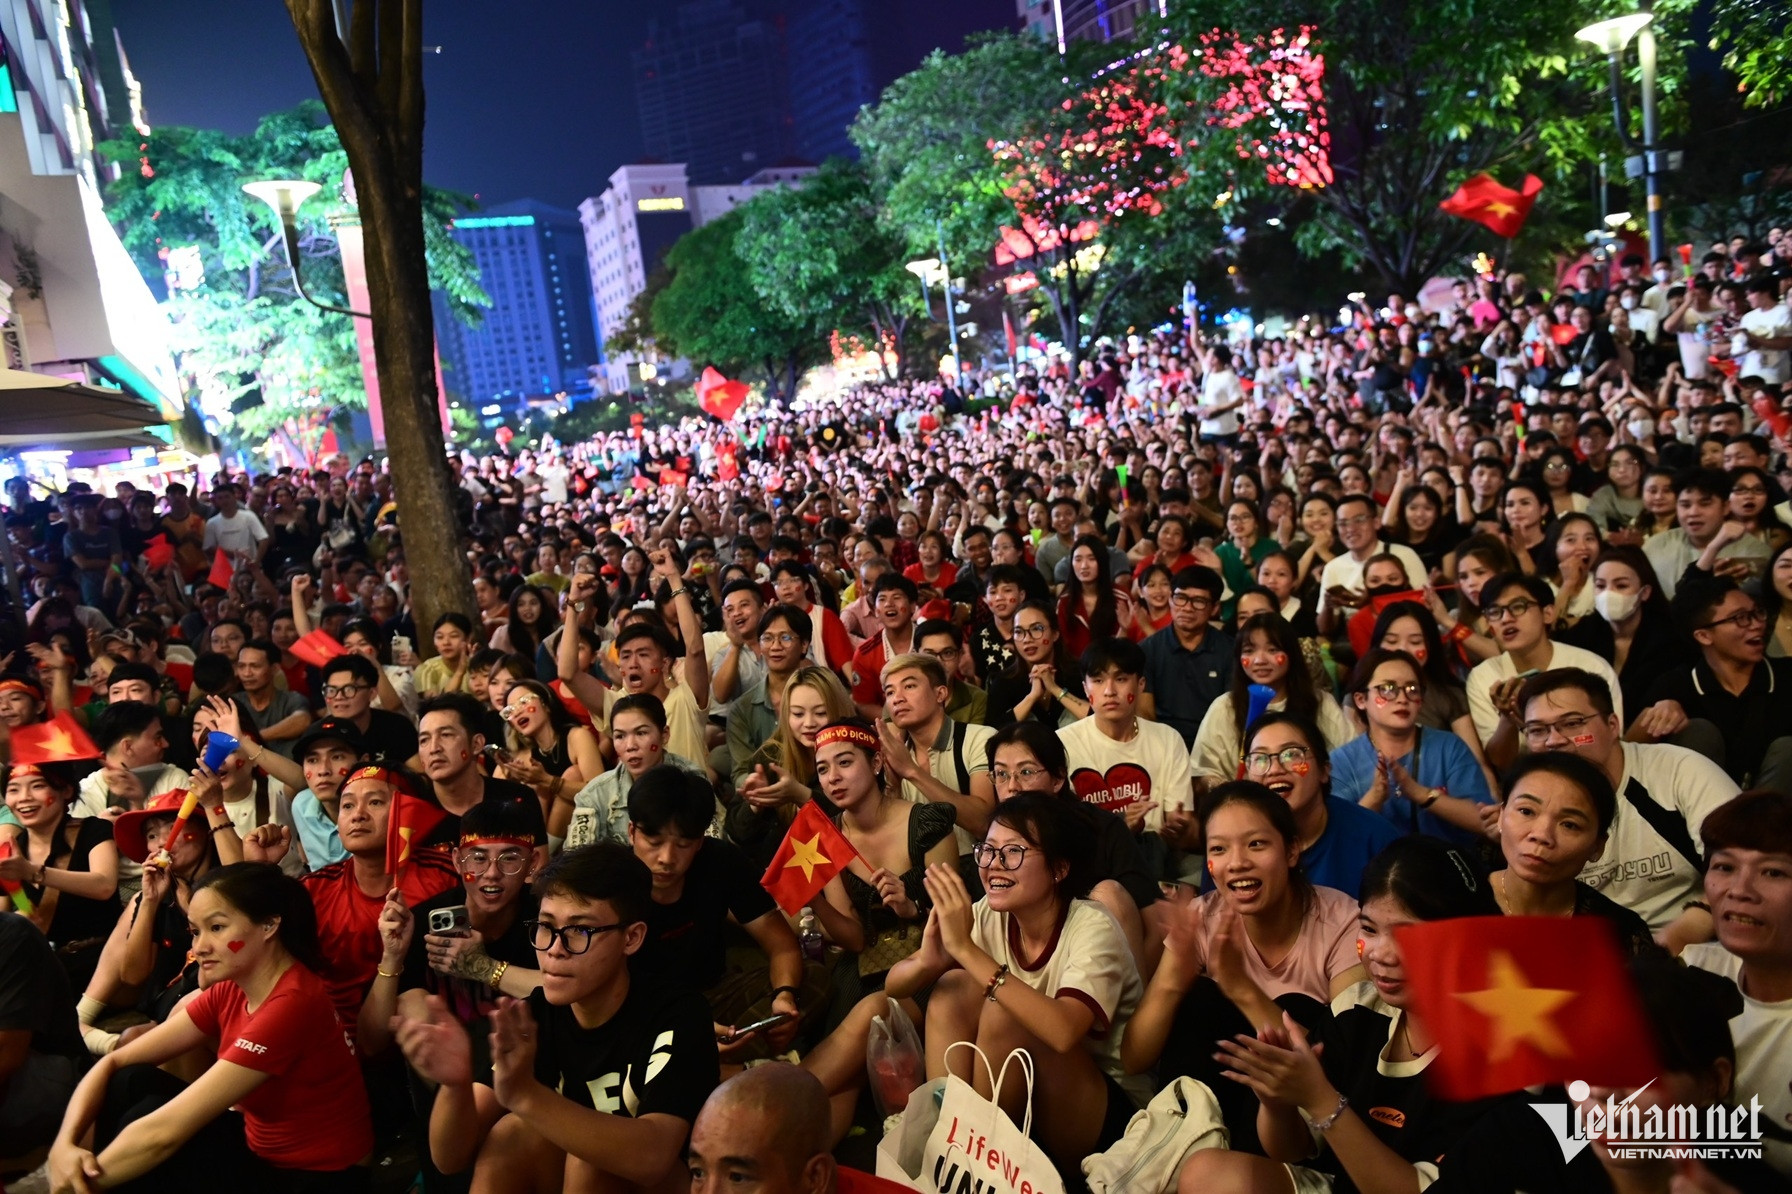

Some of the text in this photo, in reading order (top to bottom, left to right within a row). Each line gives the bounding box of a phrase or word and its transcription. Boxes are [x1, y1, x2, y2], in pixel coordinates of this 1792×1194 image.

[835, 727, 848, 737] VÔ
[849, 730, 869, 741] ĐỊCH
[1081, 789, 1112, 804] OUR
[234, 1038, 267, 1055] STAFF
[946, 1117, 1044, 1194] LifeWe
